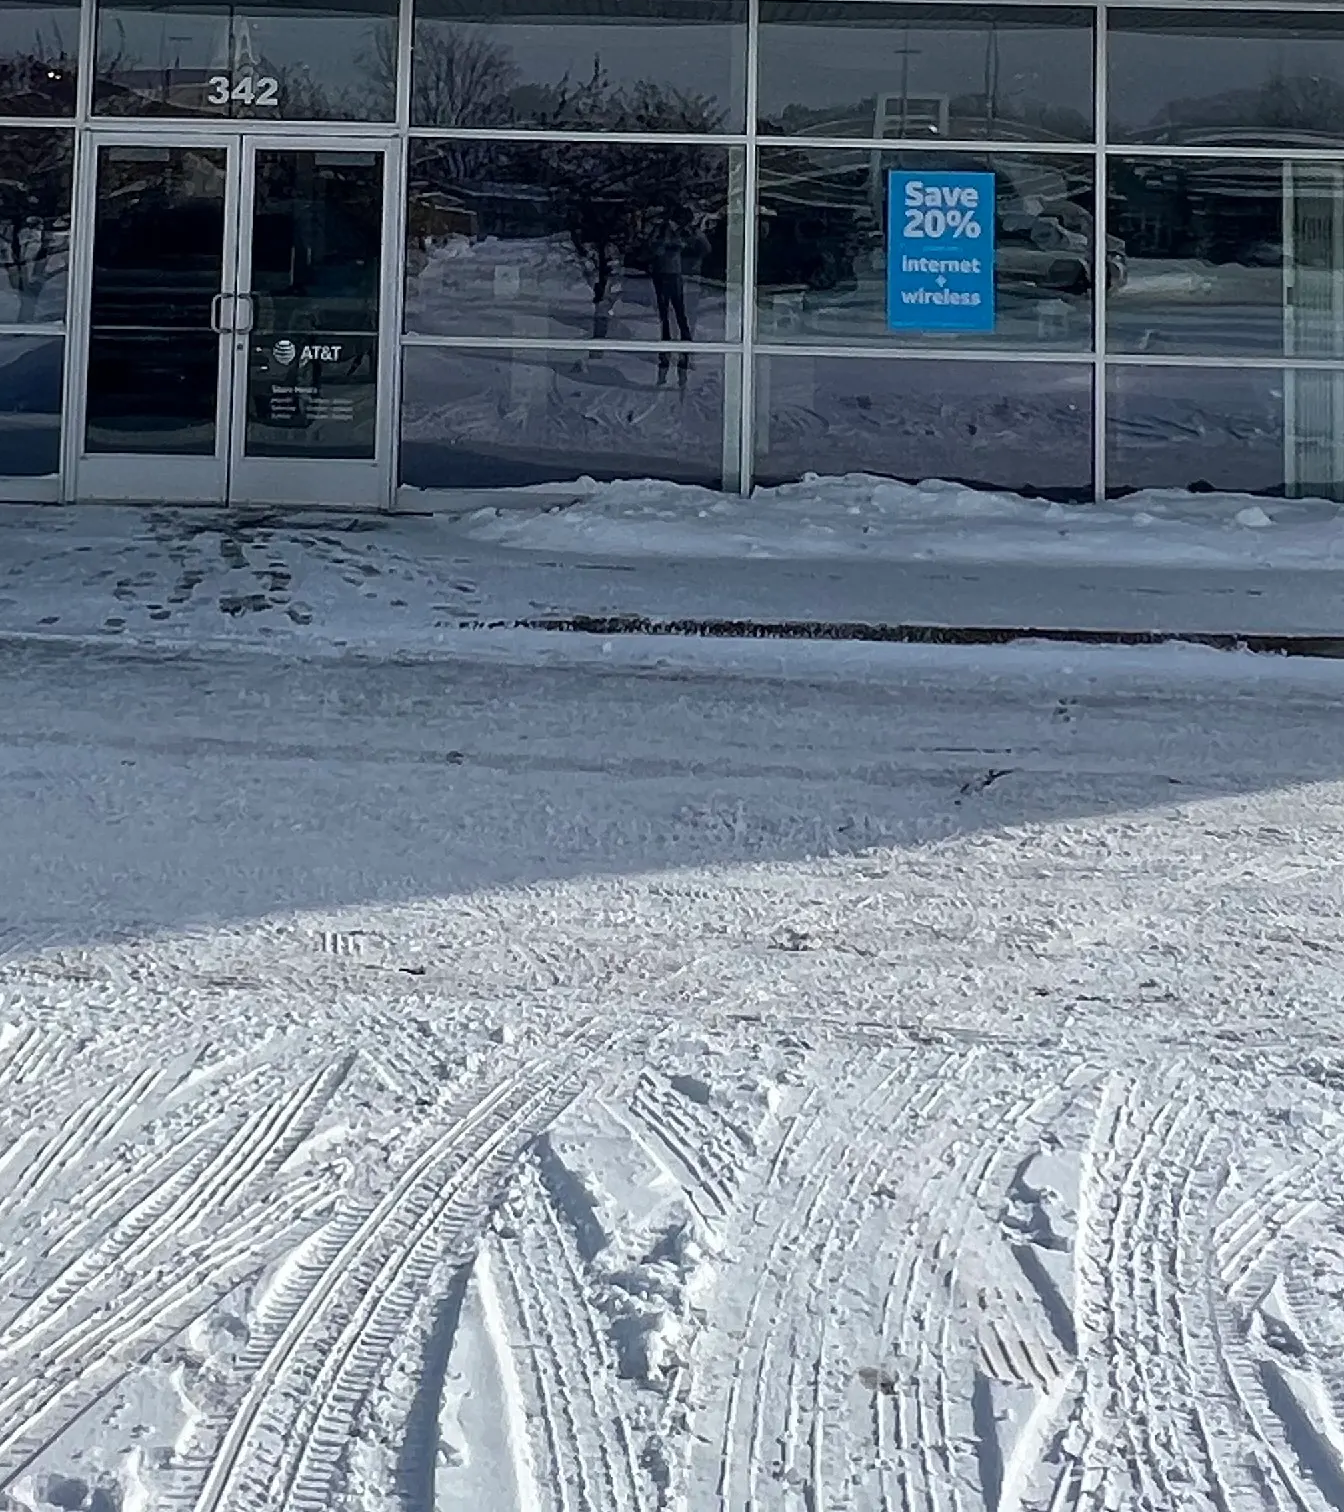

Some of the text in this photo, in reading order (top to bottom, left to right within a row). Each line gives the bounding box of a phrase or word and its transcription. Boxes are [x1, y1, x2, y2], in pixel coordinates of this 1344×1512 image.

[208, 76, 278, 106] 342
[904, 180, 979, 208] Save
[903, 208, 982, 239] 20%
[900, 288, 982, 306] wireless
[300, 345, 342, 361] AT&T
